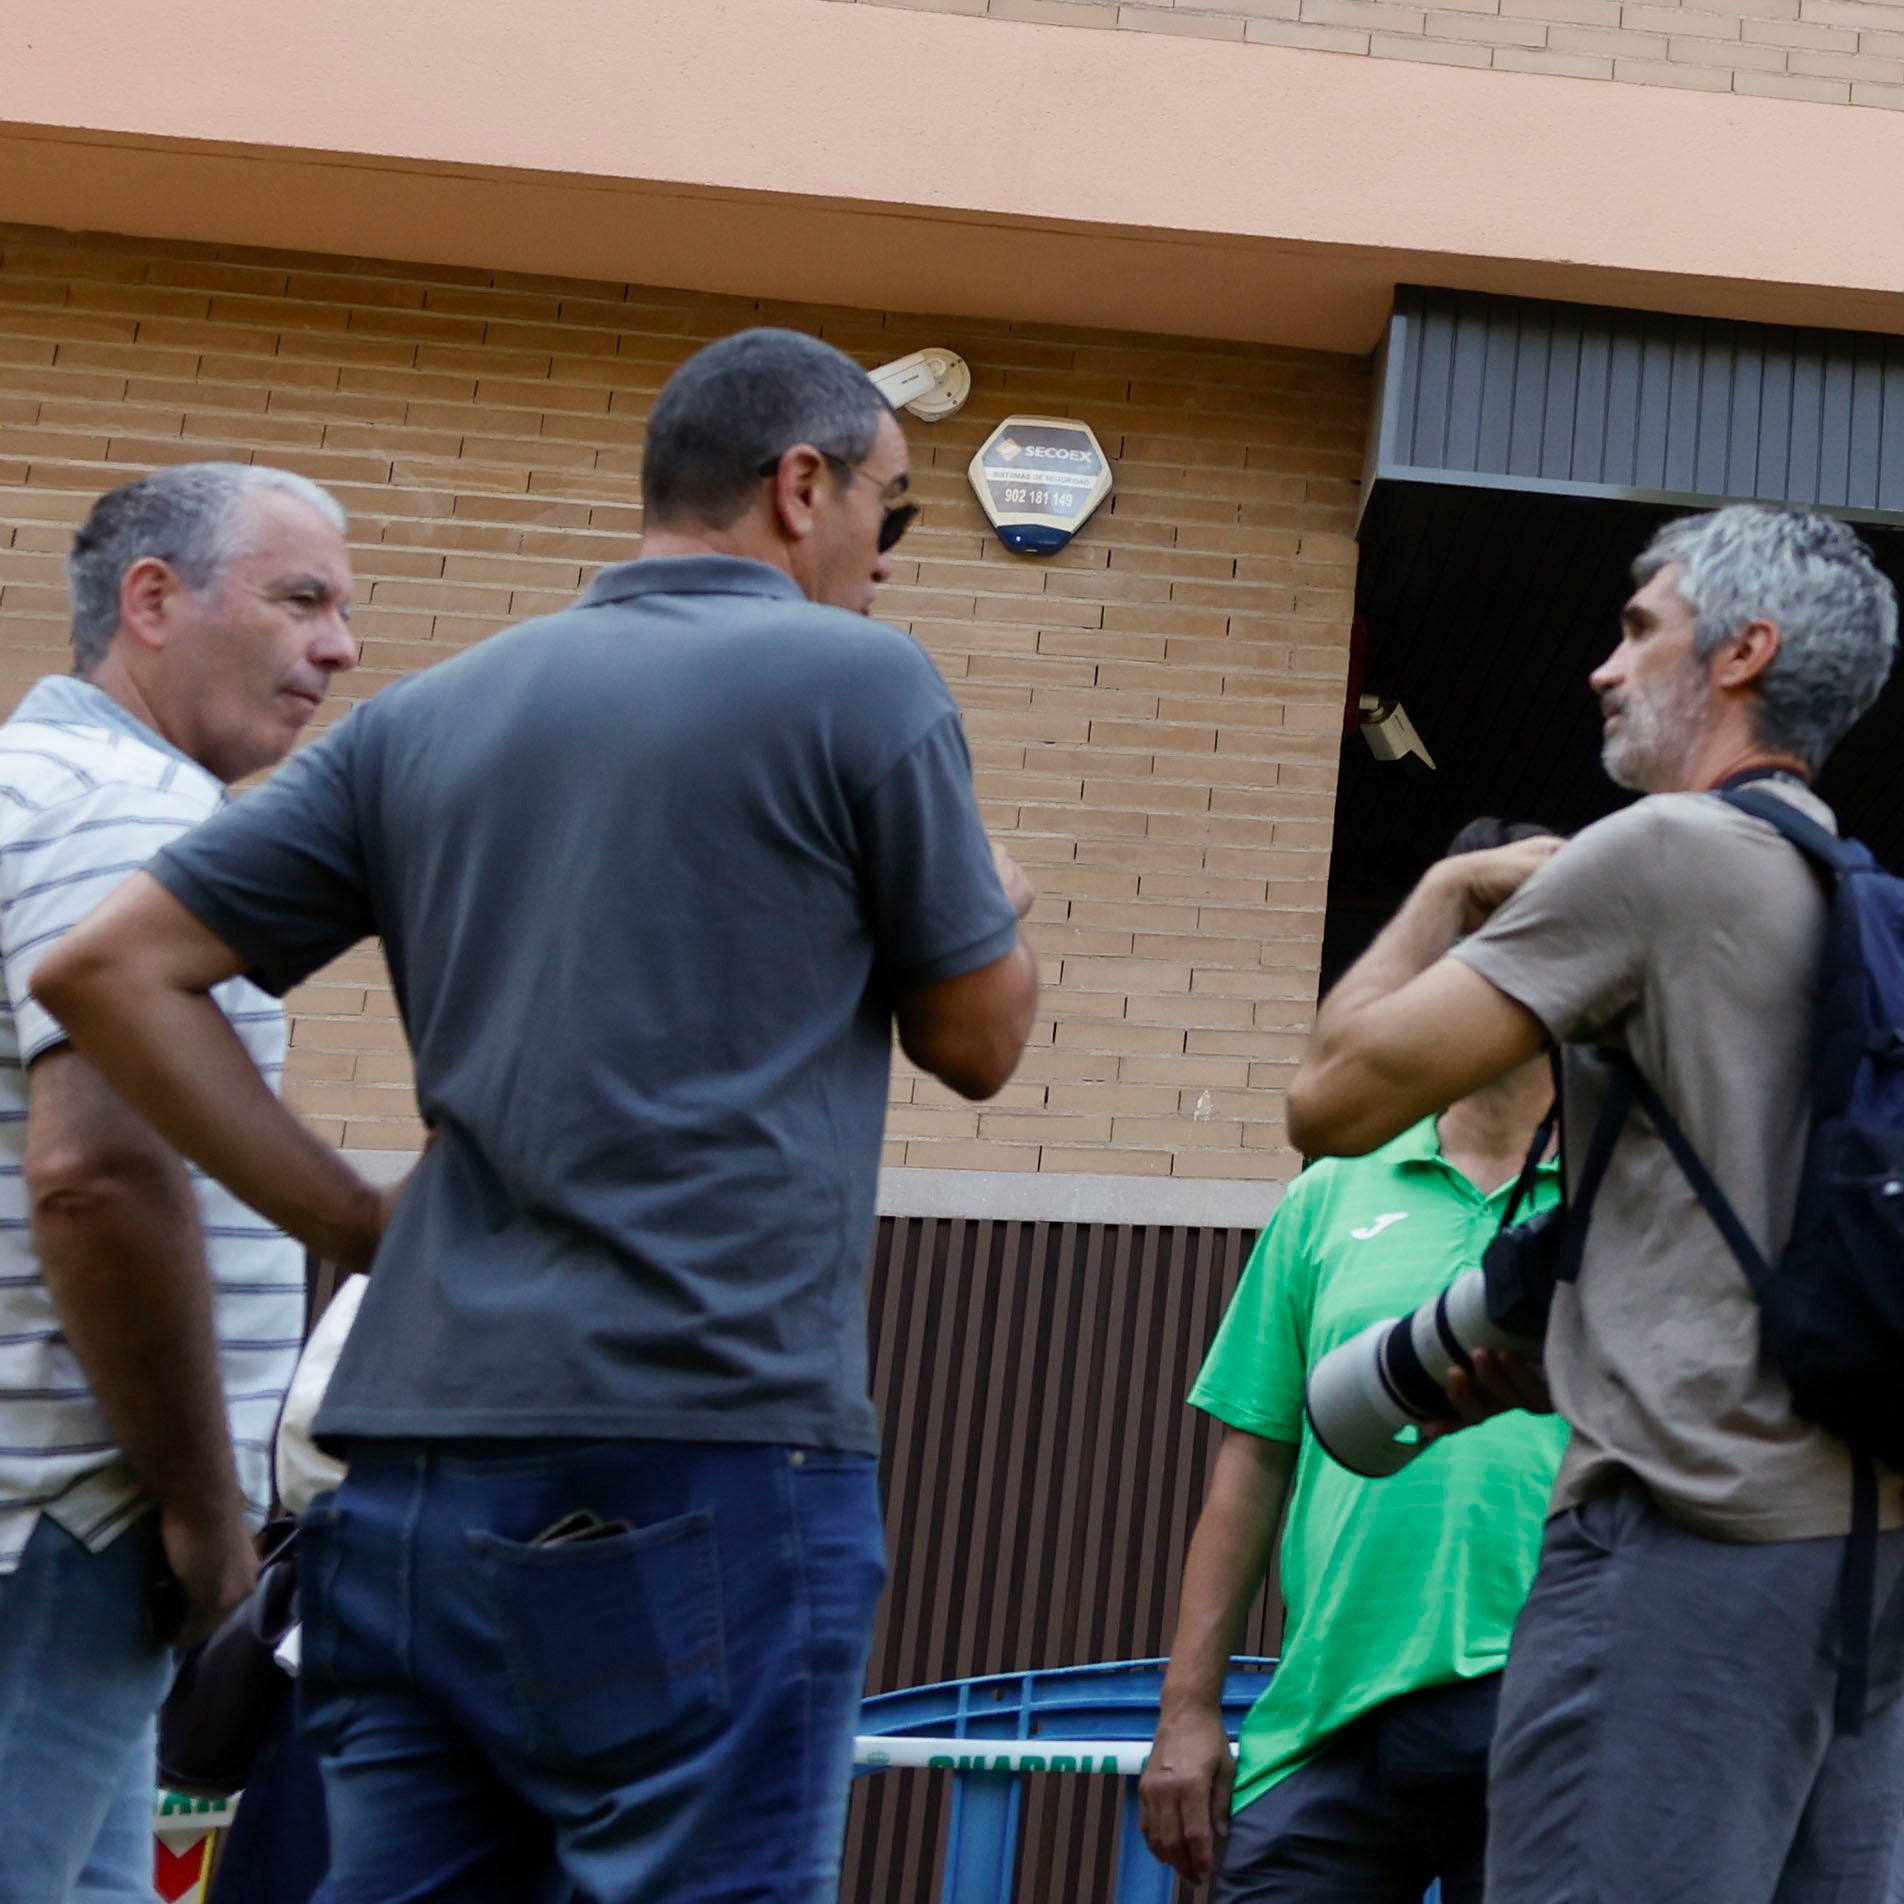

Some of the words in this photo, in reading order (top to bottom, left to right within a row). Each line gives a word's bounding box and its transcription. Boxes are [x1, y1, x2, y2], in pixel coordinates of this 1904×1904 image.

[1025, 445, 1093, 463] SECOEX
[1004, 488, 1026, 503] 902
[1029, 490, 1049, 504] 181
[1053, 492, 1073, 507] 149
